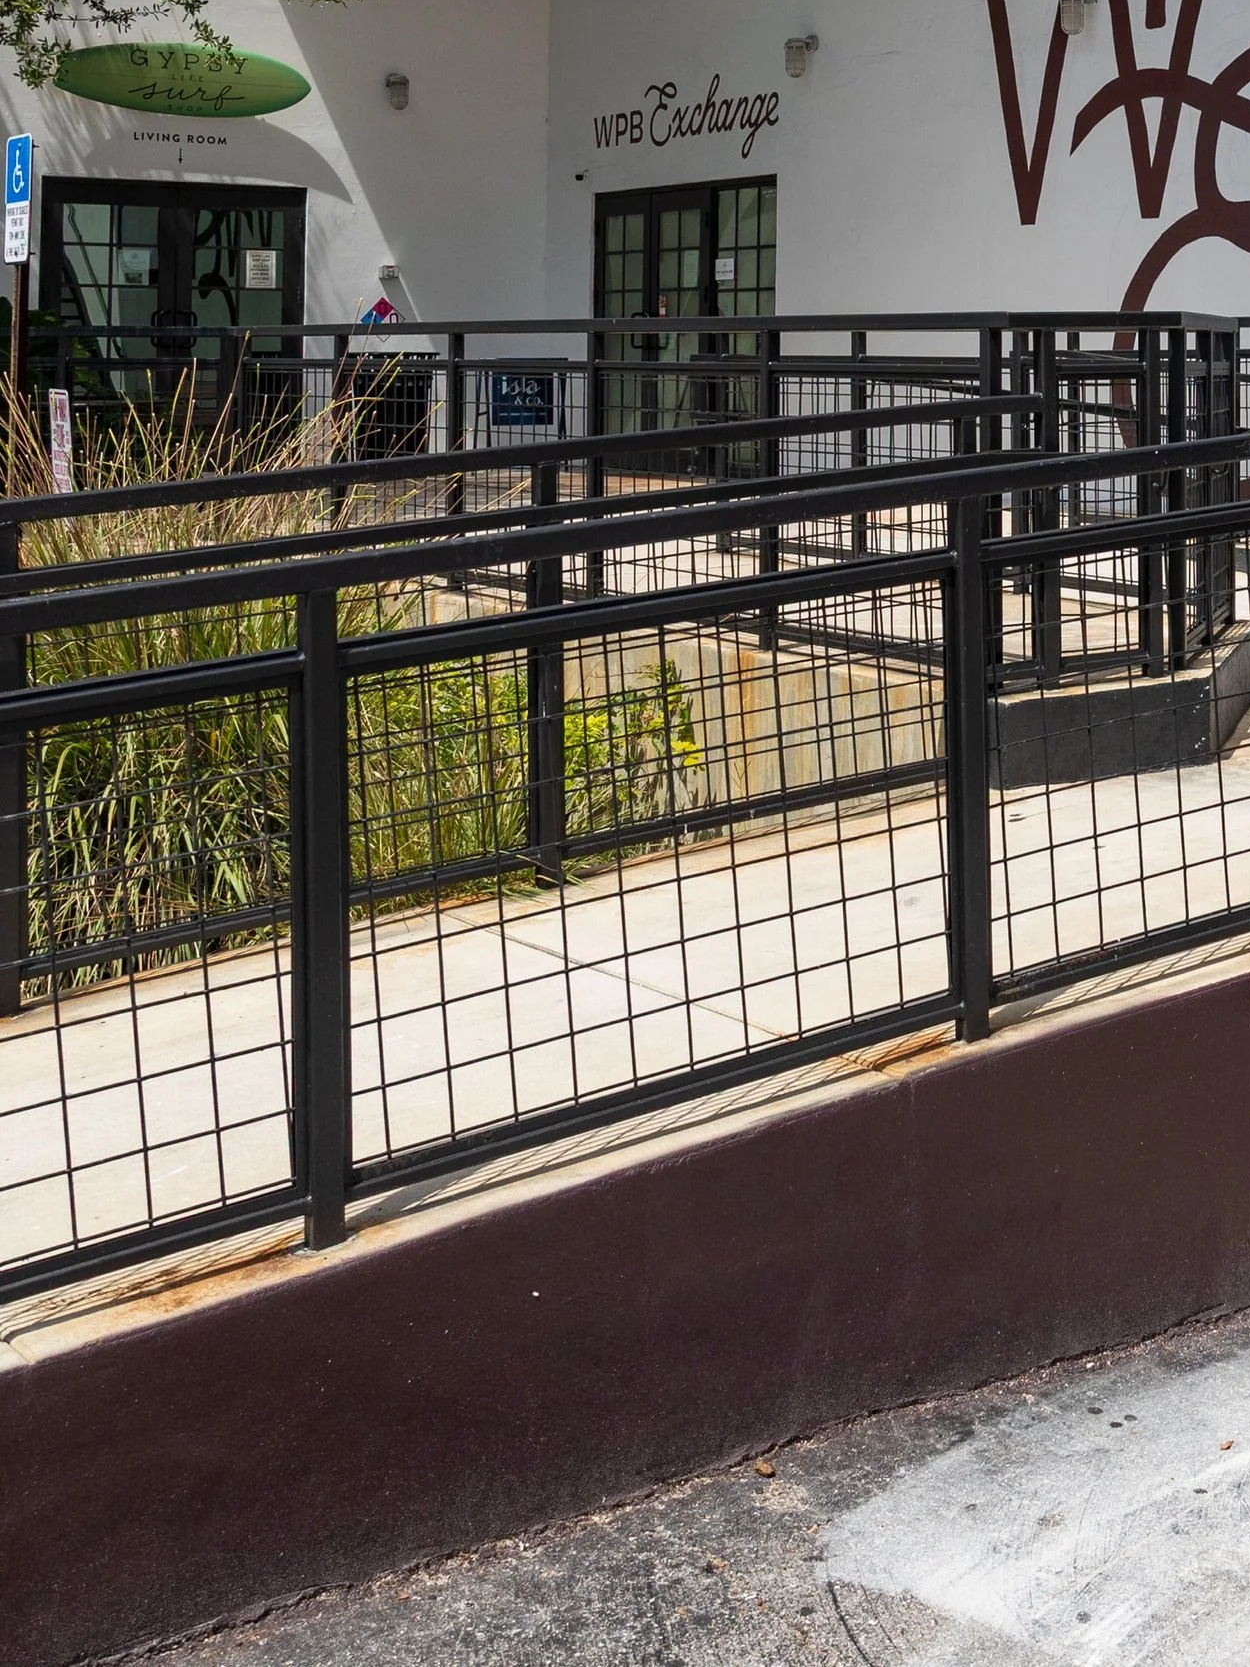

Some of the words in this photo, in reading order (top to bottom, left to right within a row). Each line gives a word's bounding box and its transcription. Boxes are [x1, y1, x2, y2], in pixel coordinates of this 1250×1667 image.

[130, 48, 249, 75] GYPSY
[128, 81, 245, 111] surf
[594, 109, 643, 149] WPB
[644, 73, 779, 159] Exchange
[133, 132, 180, 143] LIVING
[187, 135, 227, 145] ROOM
[502, 376, 541, 395] isla
[514, 396, 522, 406] &
